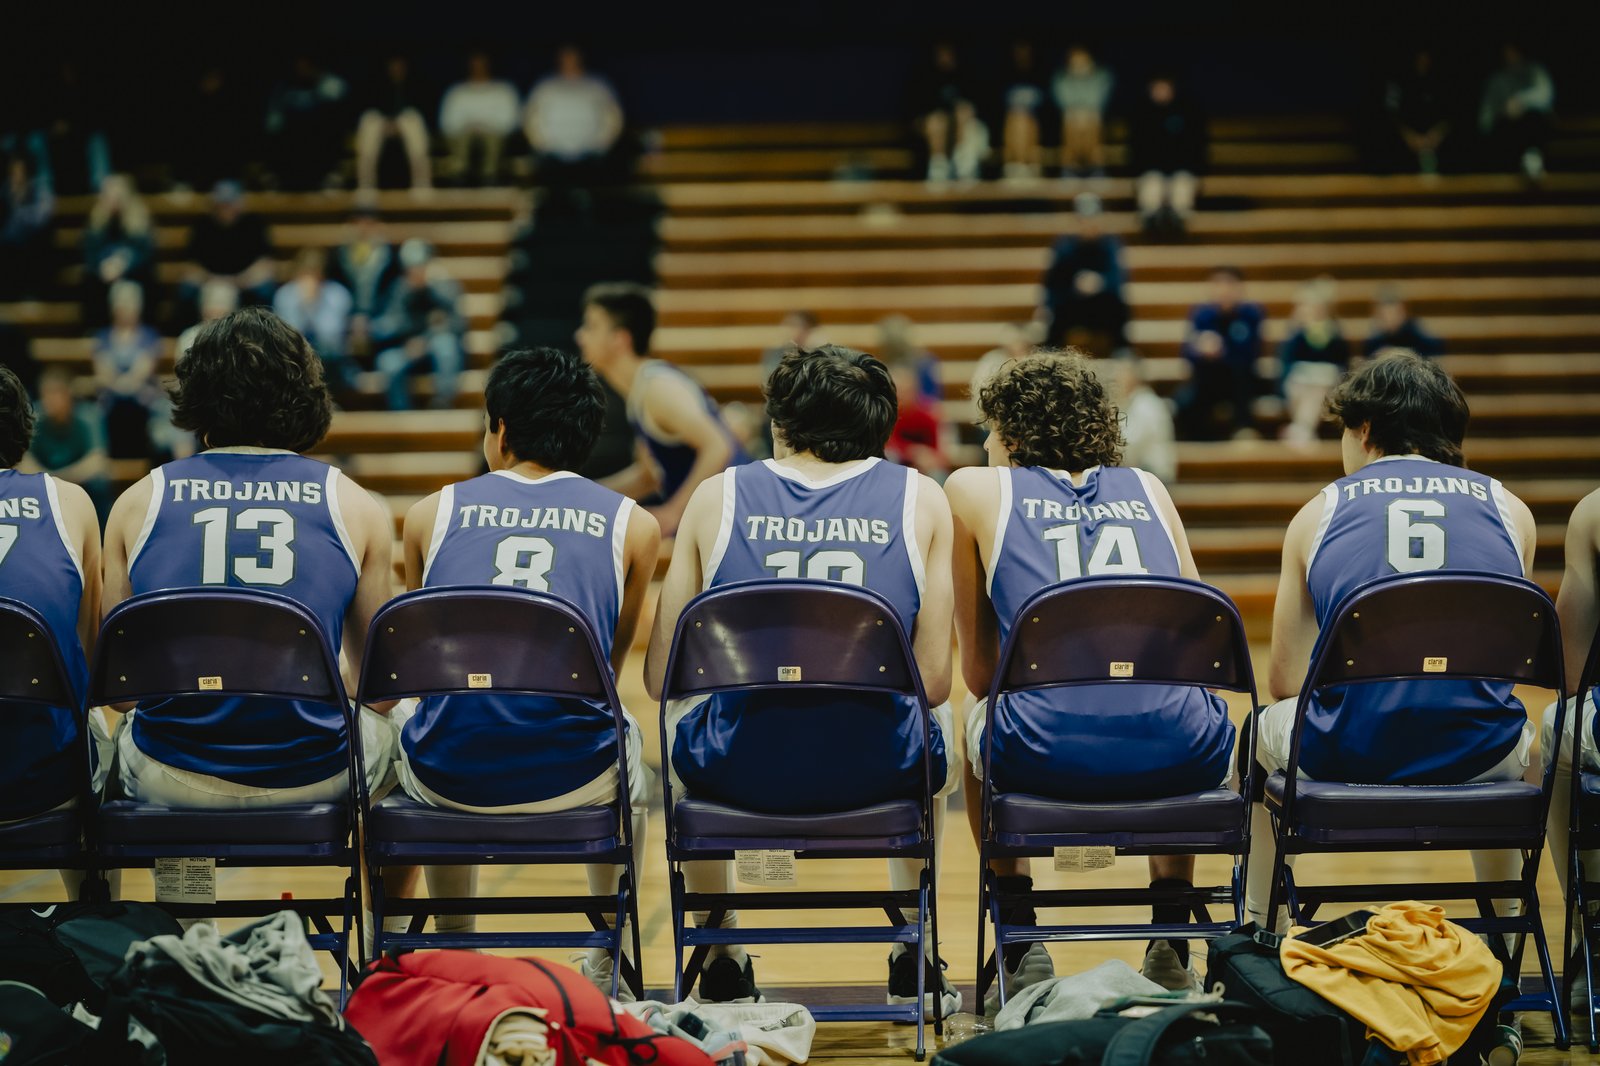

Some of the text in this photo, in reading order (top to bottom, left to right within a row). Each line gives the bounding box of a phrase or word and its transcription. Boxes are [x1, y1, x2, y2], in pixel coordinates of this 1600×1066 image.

[169, 478, 322, 506] TROJANS
[1343, 475, 1488, 503] TROJANS
[459, 503, 608, 539] TROJANS
[746, 515, 891, 545] TROJANS
[1384, 498, 1449, 574] 6
[193, 507, 295, 586] 13
[490, 535, 558, 593] 8
[1043, 523, 1152, 581] 14
